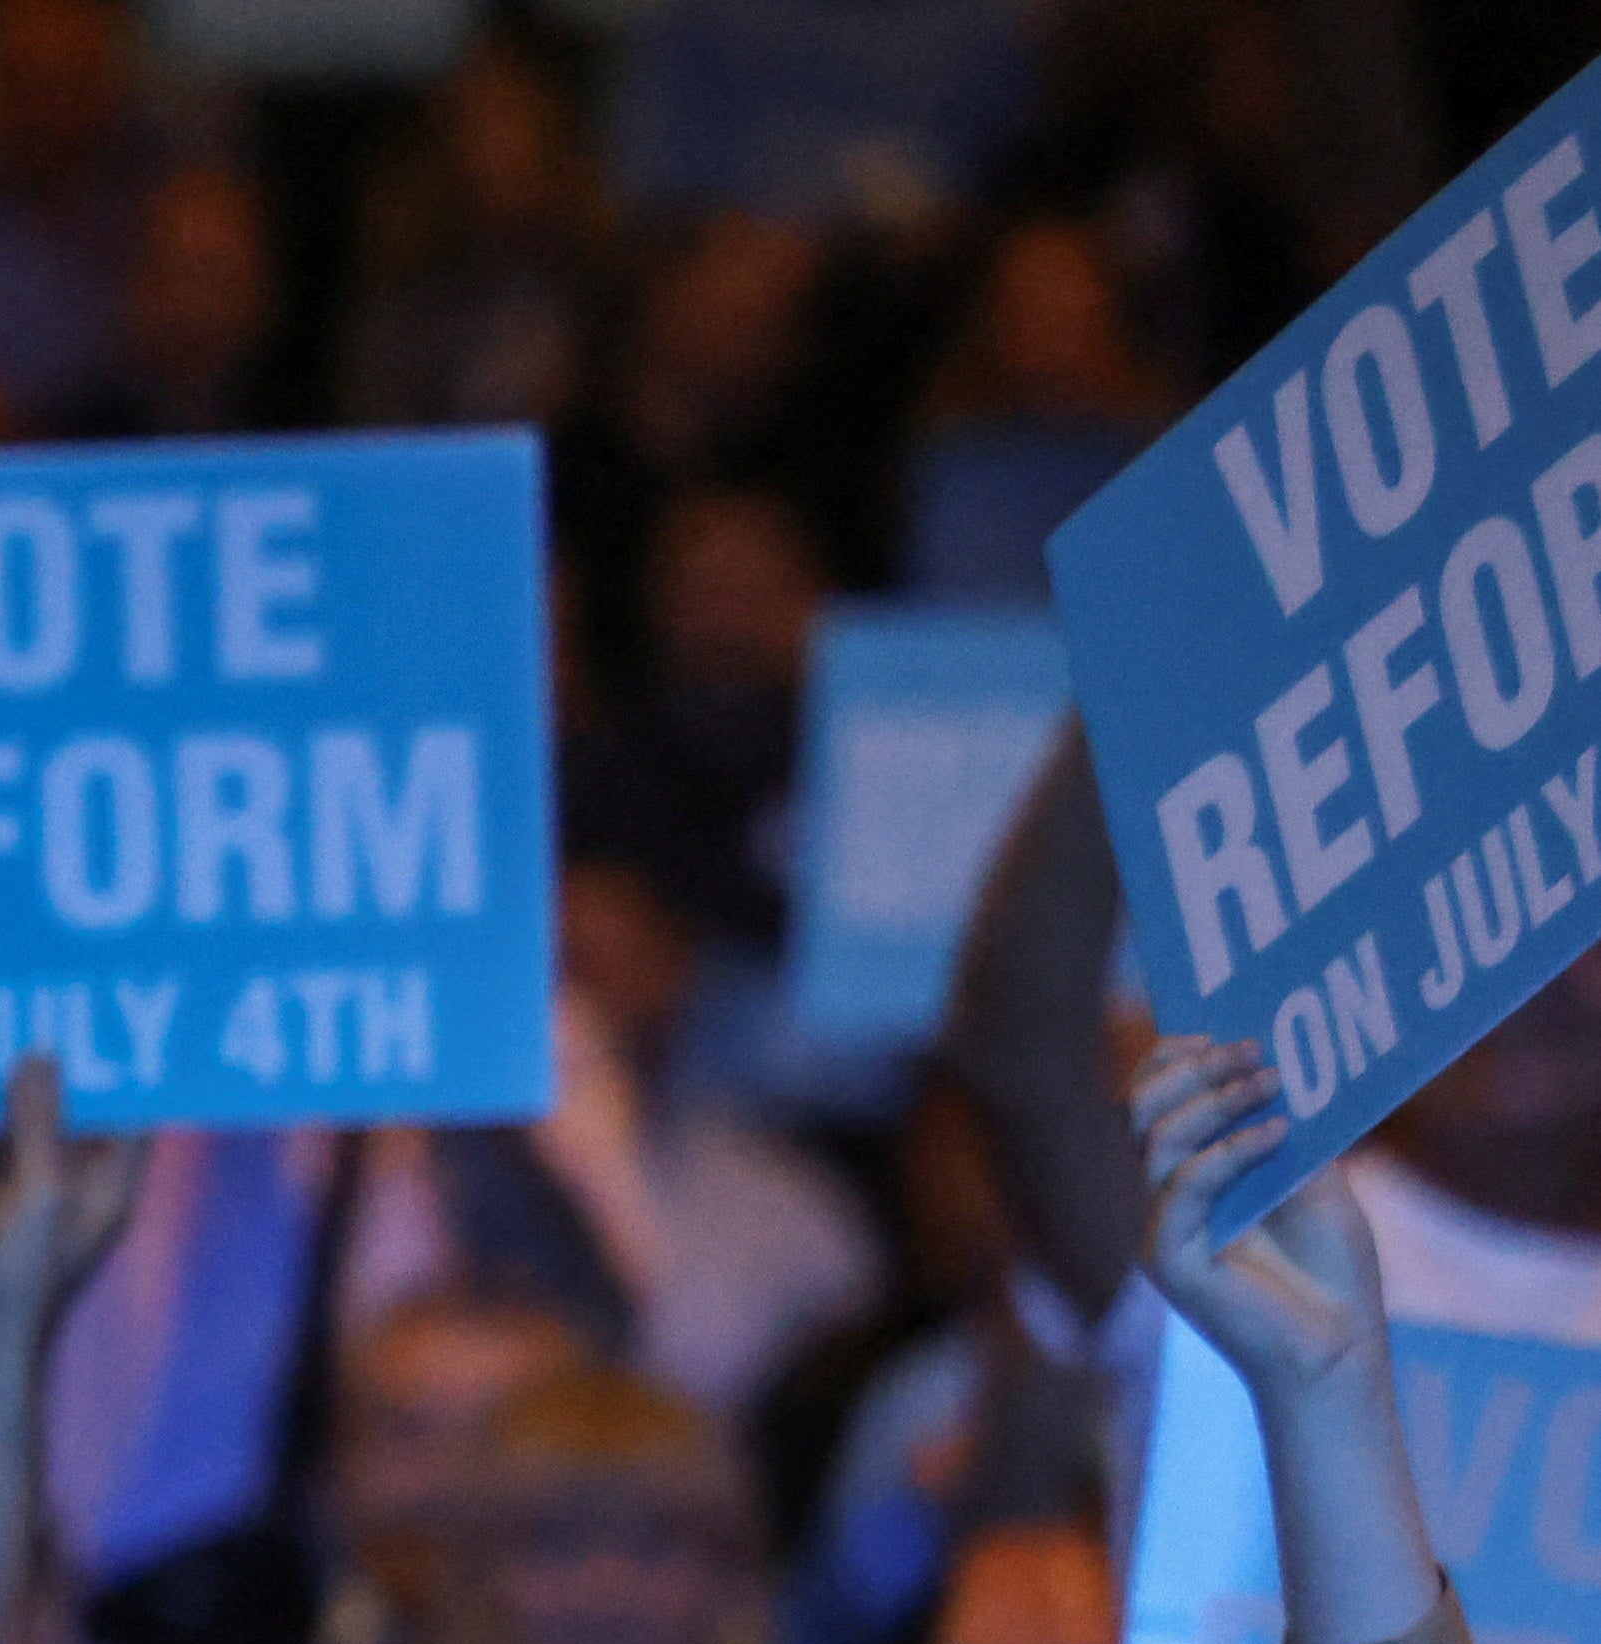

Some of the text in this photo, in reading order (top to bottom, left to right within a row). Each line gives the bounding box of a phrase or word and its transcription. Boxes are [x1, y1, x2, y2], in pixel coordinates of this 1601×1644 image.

[1213, 133, 1601, 620] VOTE
[219, 965, 436, 1087] 4TH
[1273, 745, 1601, 1121] ON JULY
